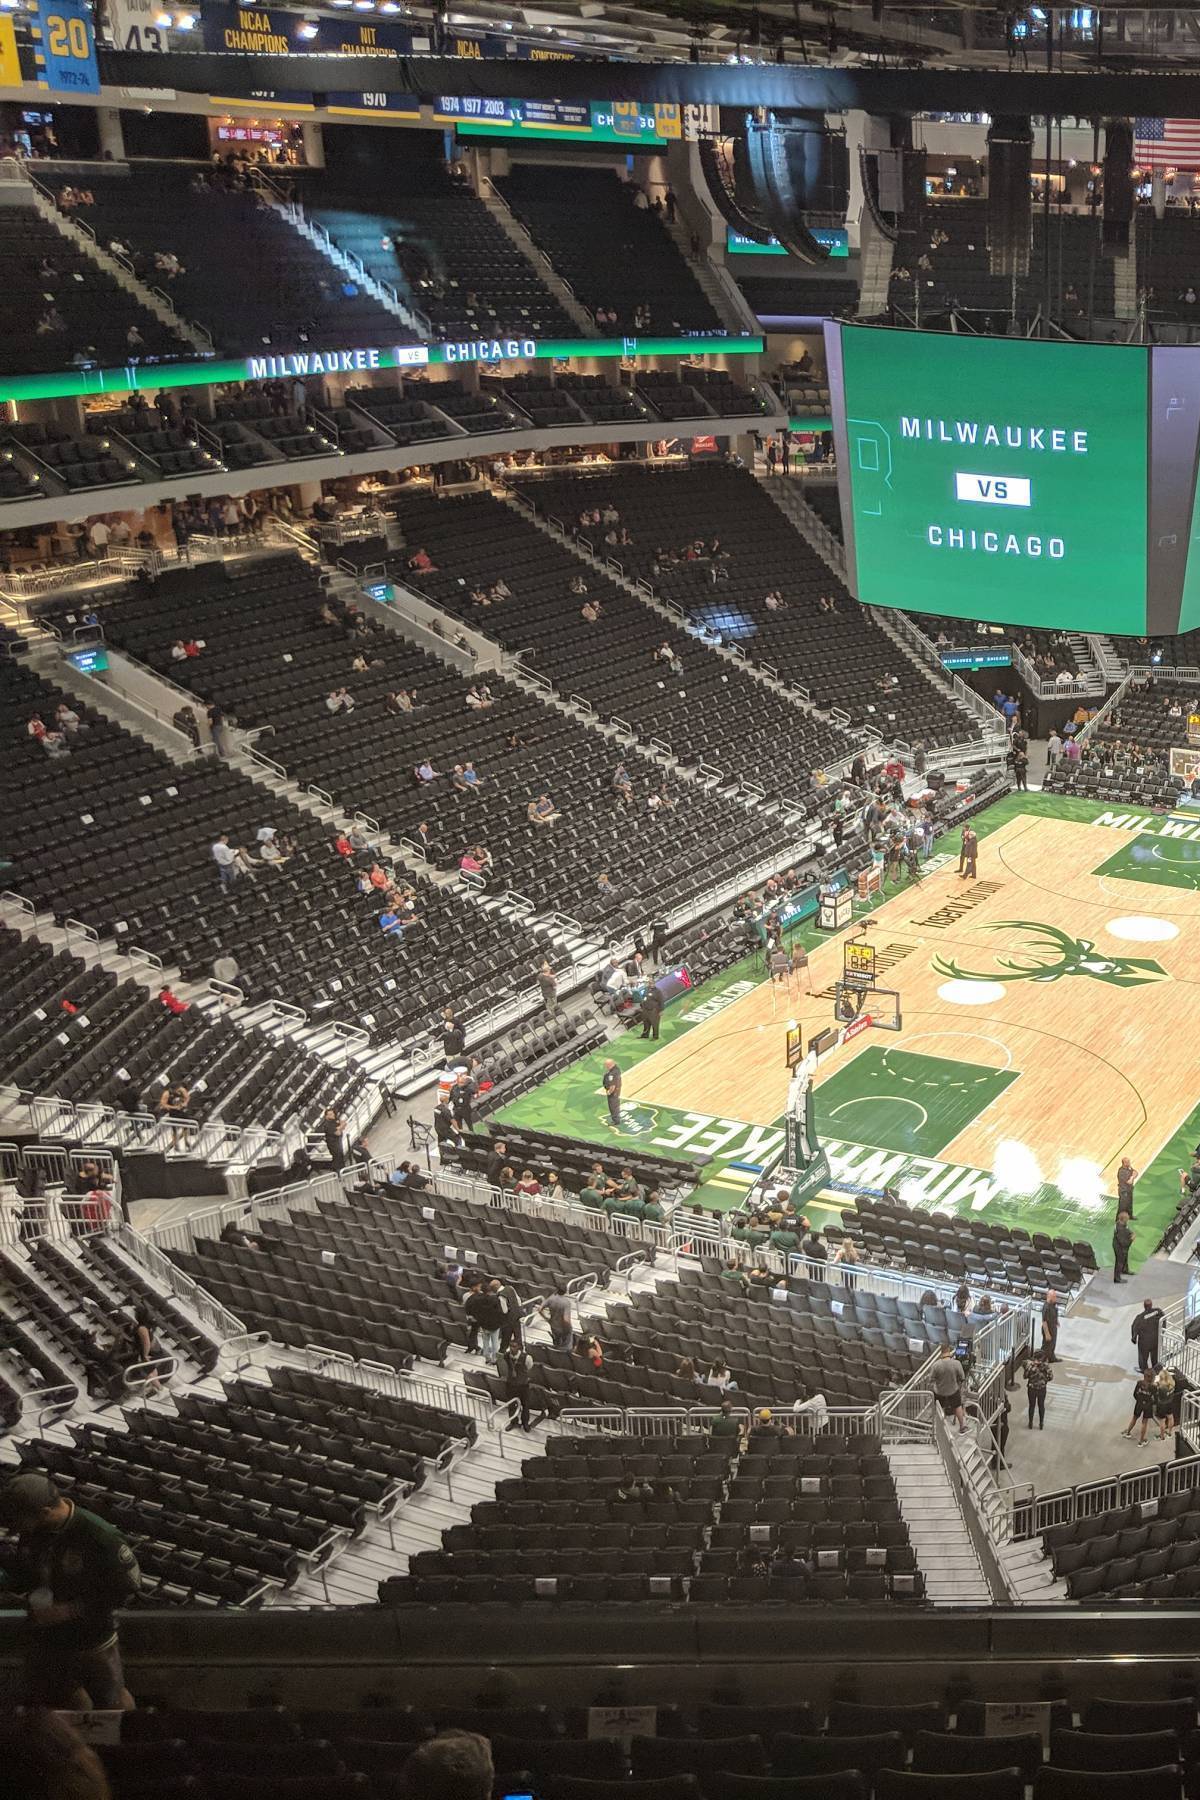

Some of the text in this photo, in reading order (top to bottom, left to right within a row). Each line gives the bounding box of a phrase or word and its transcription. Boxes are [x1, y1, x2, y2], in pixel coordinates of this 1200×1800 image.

[238, 10, 272, 33] NCAA
[47, 15, 90, 59] 20
[223, 29, 290, 53] CHAMPIONS
[359, 26, 377, 45] NIT
[456, 40, 481, 57] NCAA
[440, 96, 460, 112] 1974
[462, 98, 482, 114] 1977
[484, 100, 505, 116] 2003
[251, 350, 380, 378] MILWAUKEE
[446, 341, 536, 361] CHICAGO
[900, 416, 1089, 452] MILWAUKEE
[977, 480, 1008, 499] VS
[927, 525, 1065, 558] CHICAGO
[680, 980, 759, 1022] BUCKS.COM
